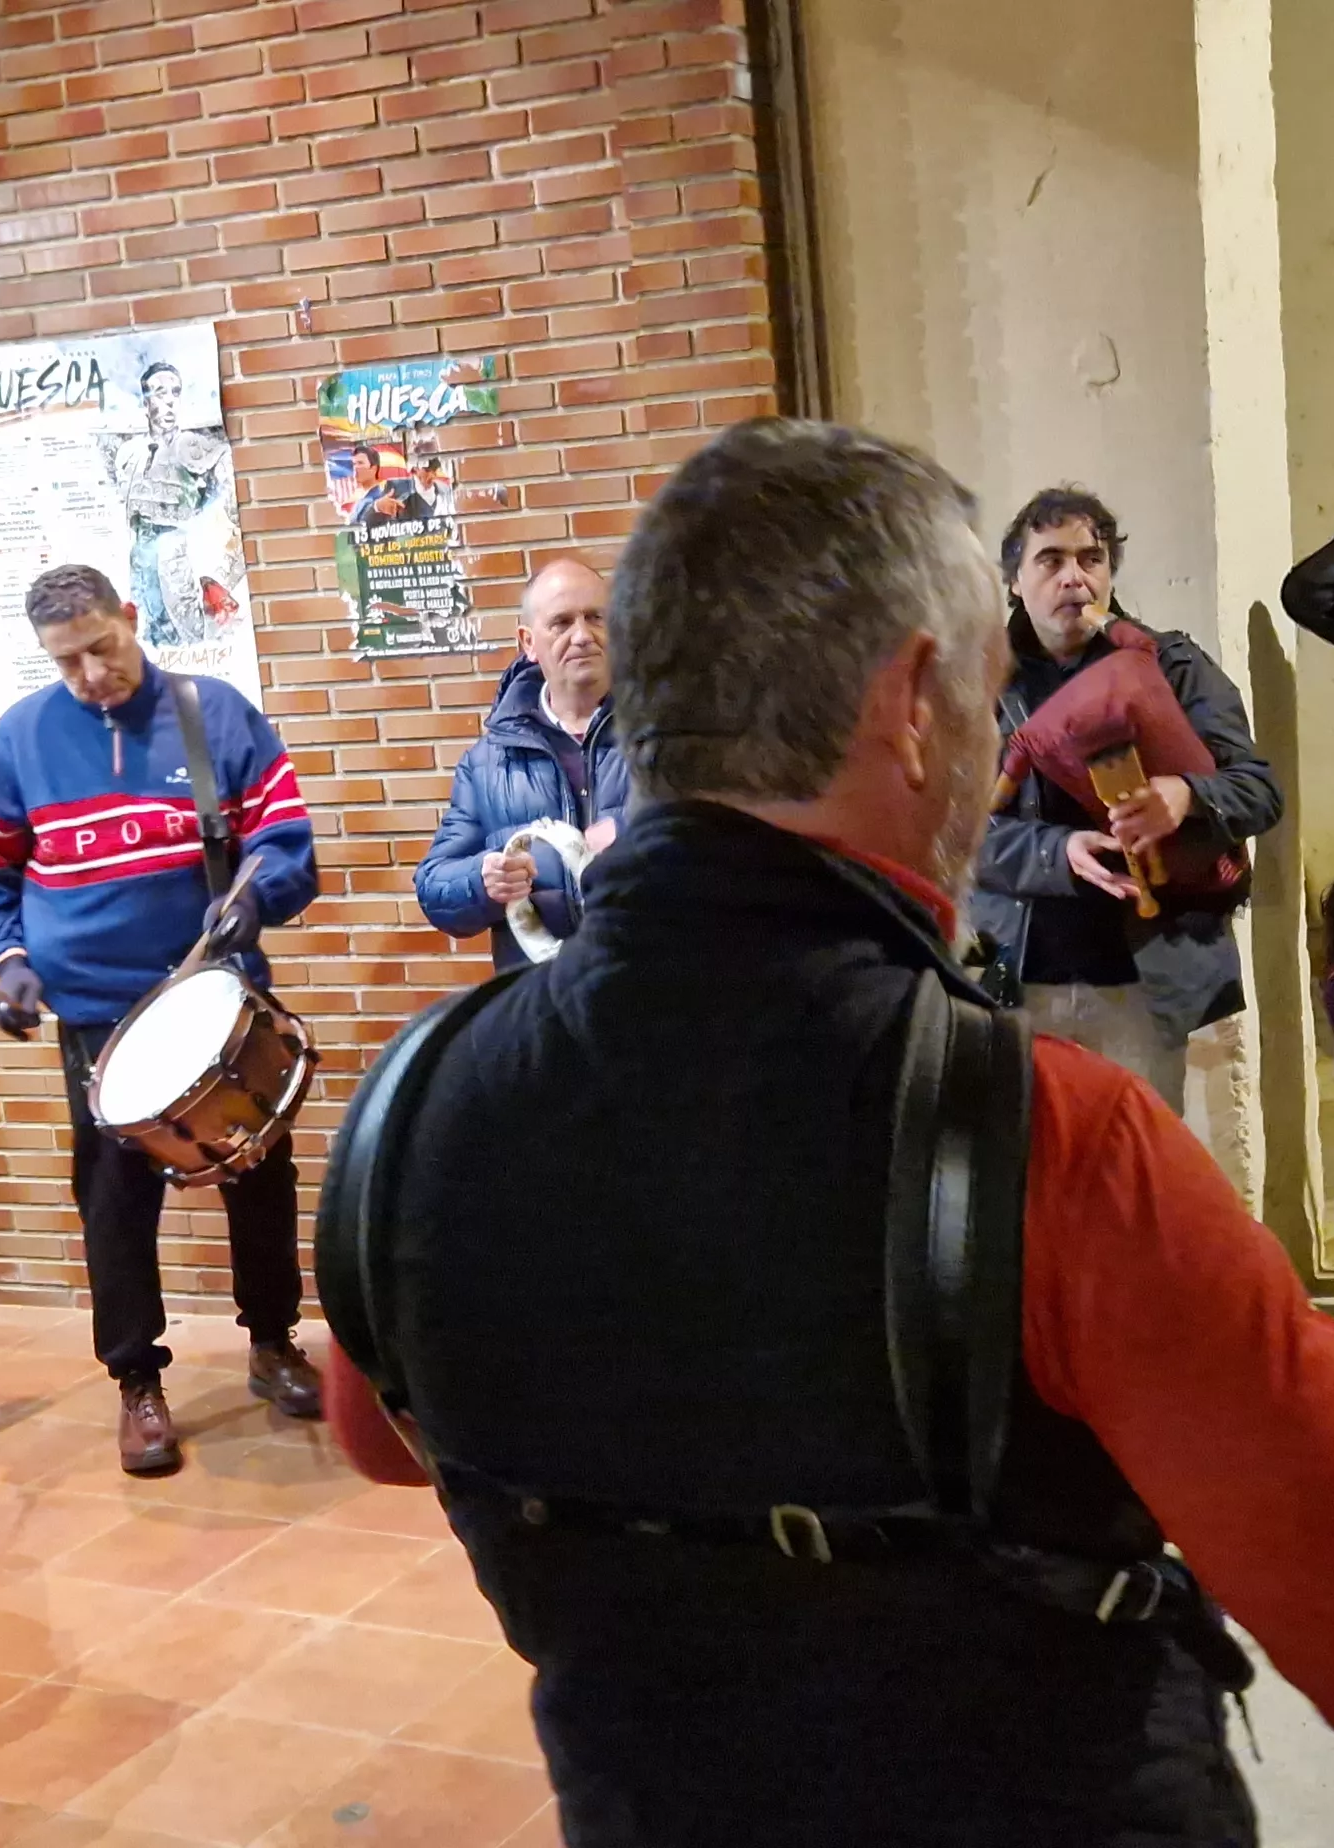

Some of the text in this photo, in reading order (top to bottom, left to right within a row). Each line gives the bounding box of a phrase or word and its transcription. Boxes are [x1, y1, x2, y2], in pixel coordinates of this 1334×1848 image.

[347, 382, 468, 431] HUESCA
[427, 518, 441, 532] DE
[368, 552, 405, 567] DOMINGO
[413, 550, 444, 563] AGOSTO
[39, 811, 185, 857] SPOR
